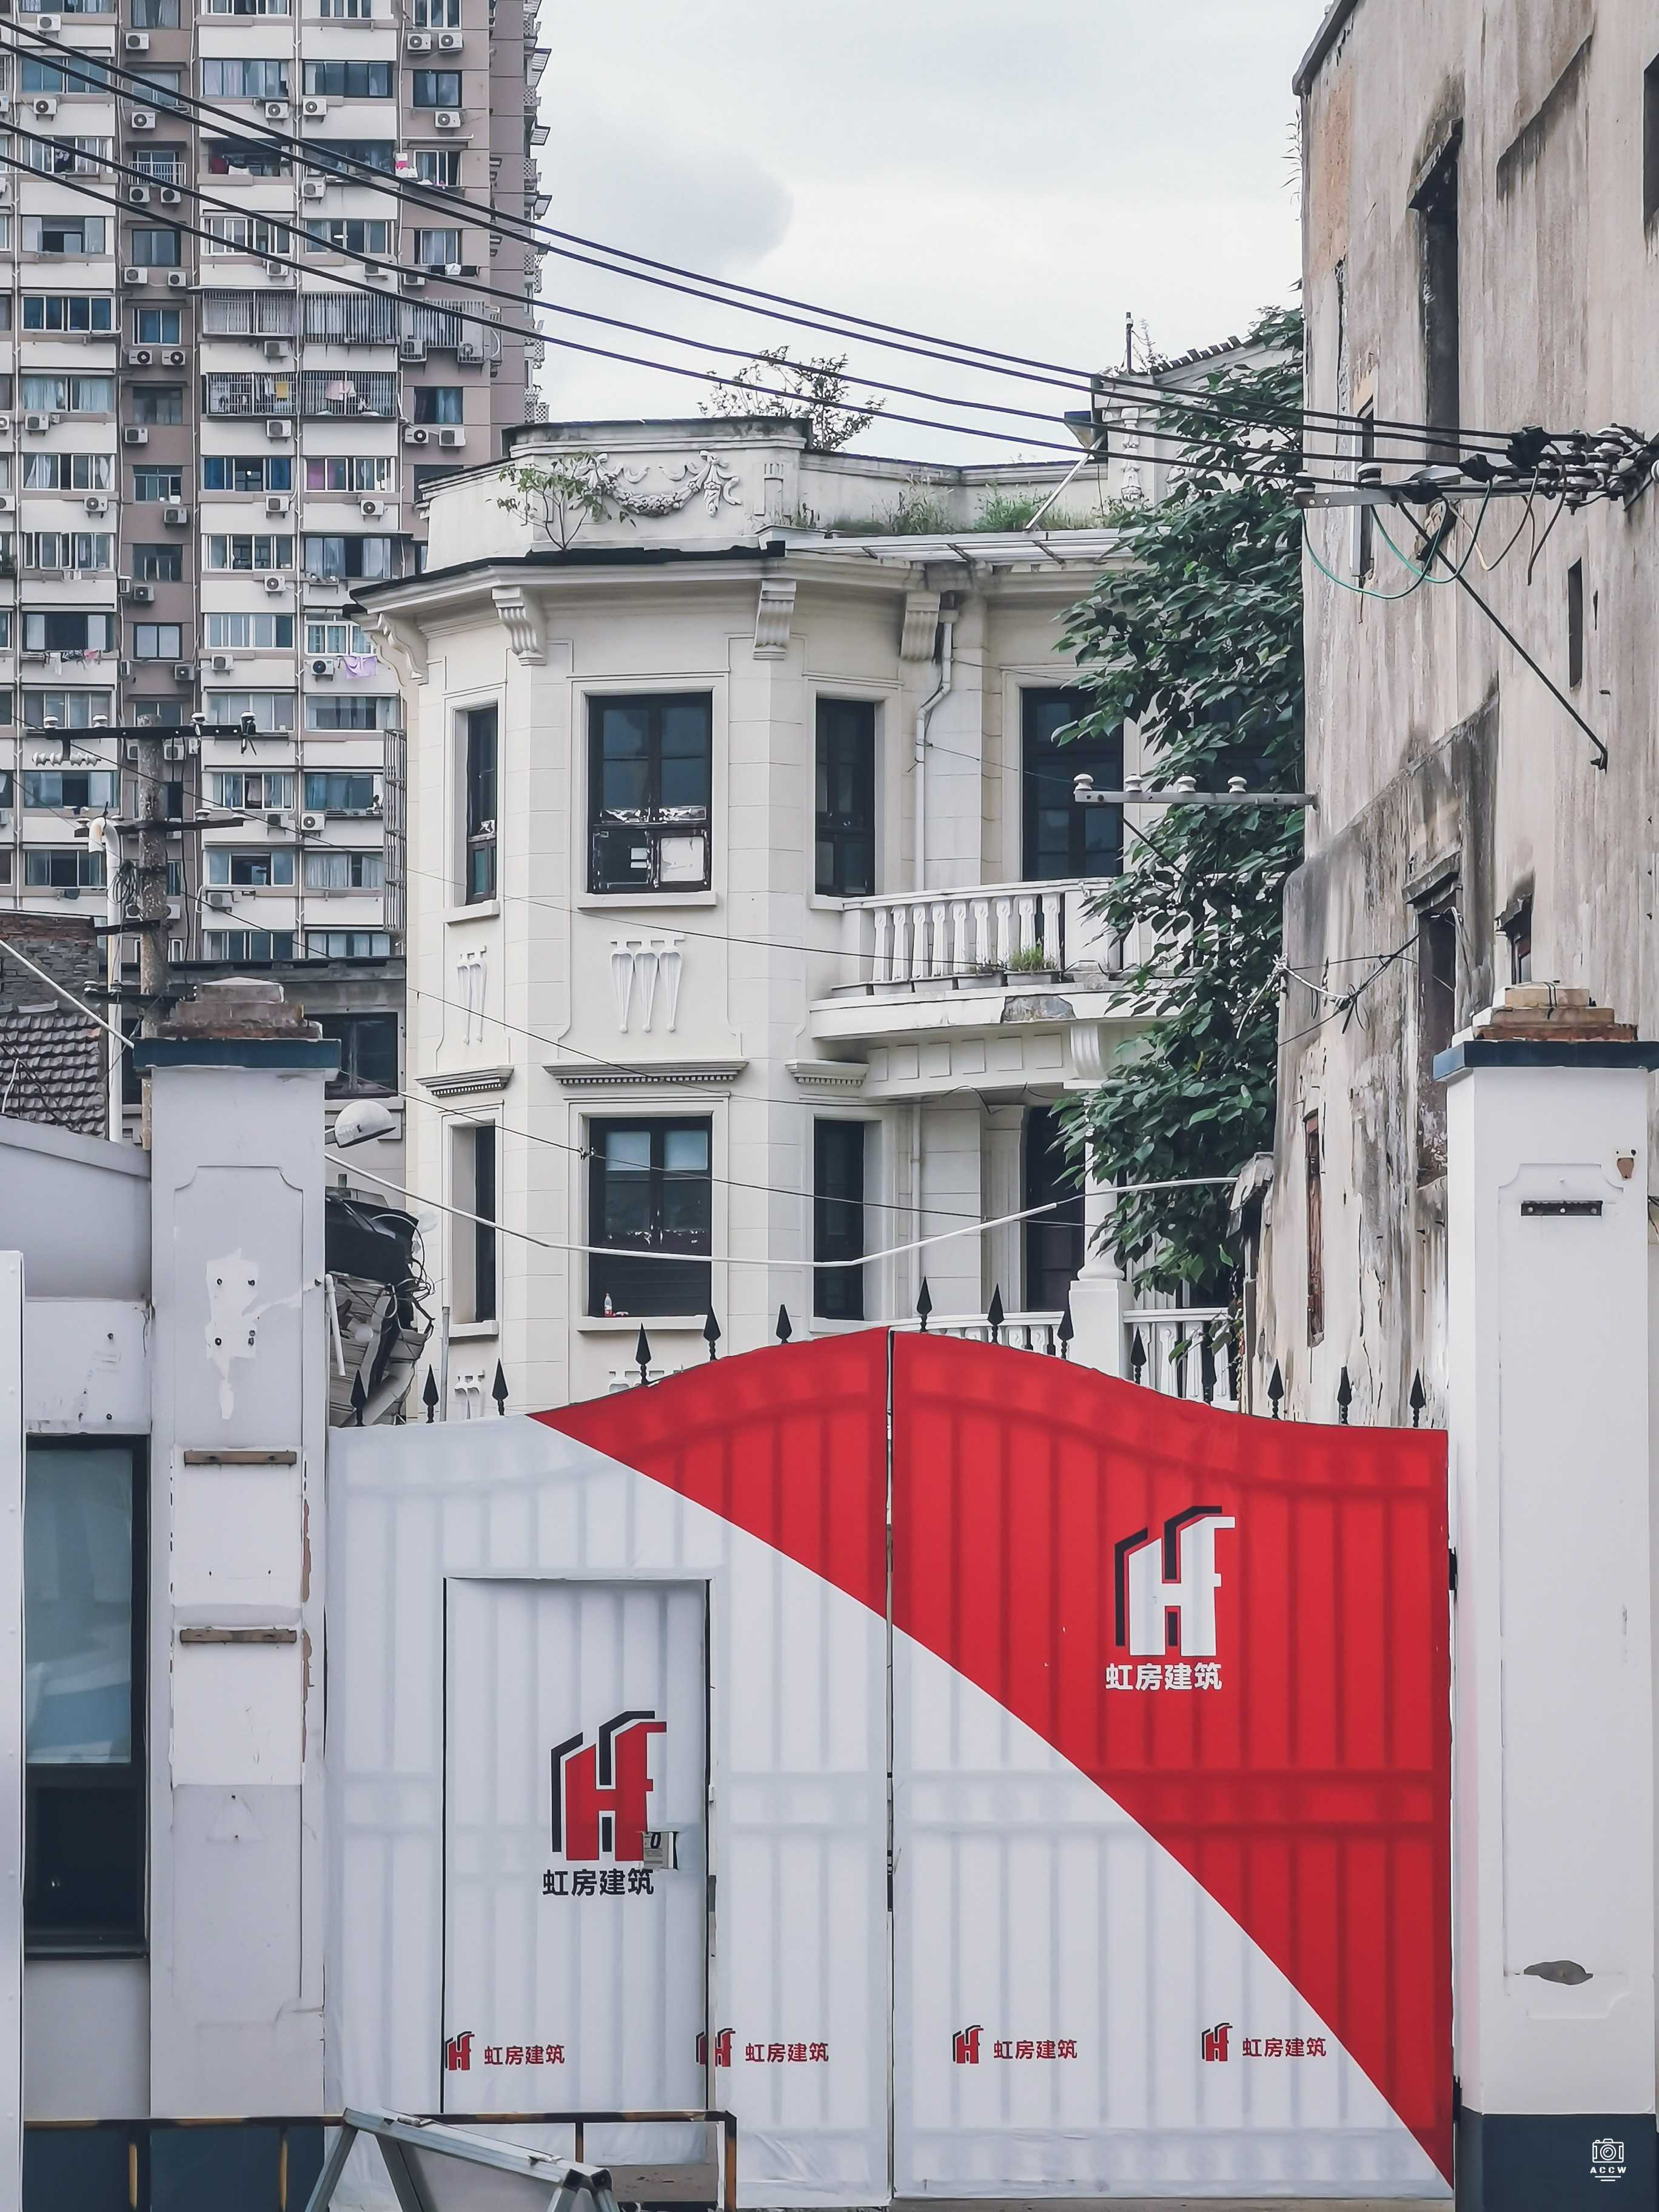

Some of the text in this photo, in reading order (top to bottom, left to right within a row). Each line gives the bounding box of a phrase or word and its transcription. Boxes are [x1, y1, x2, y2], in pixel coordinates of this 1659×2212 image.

[1105, 1663, 1222, 1691] 虹房建筑
[542, 1868, 654, 1896] 虹房建筑
[484, 2045, 565, 2065] 虹房建筑
[745, 2042, 829, 2062] 虹房建筑
[994, 2040, 1078, 2060] 虹房建筑
[1242, 2037, 1326, 2057] 虹房建筑
